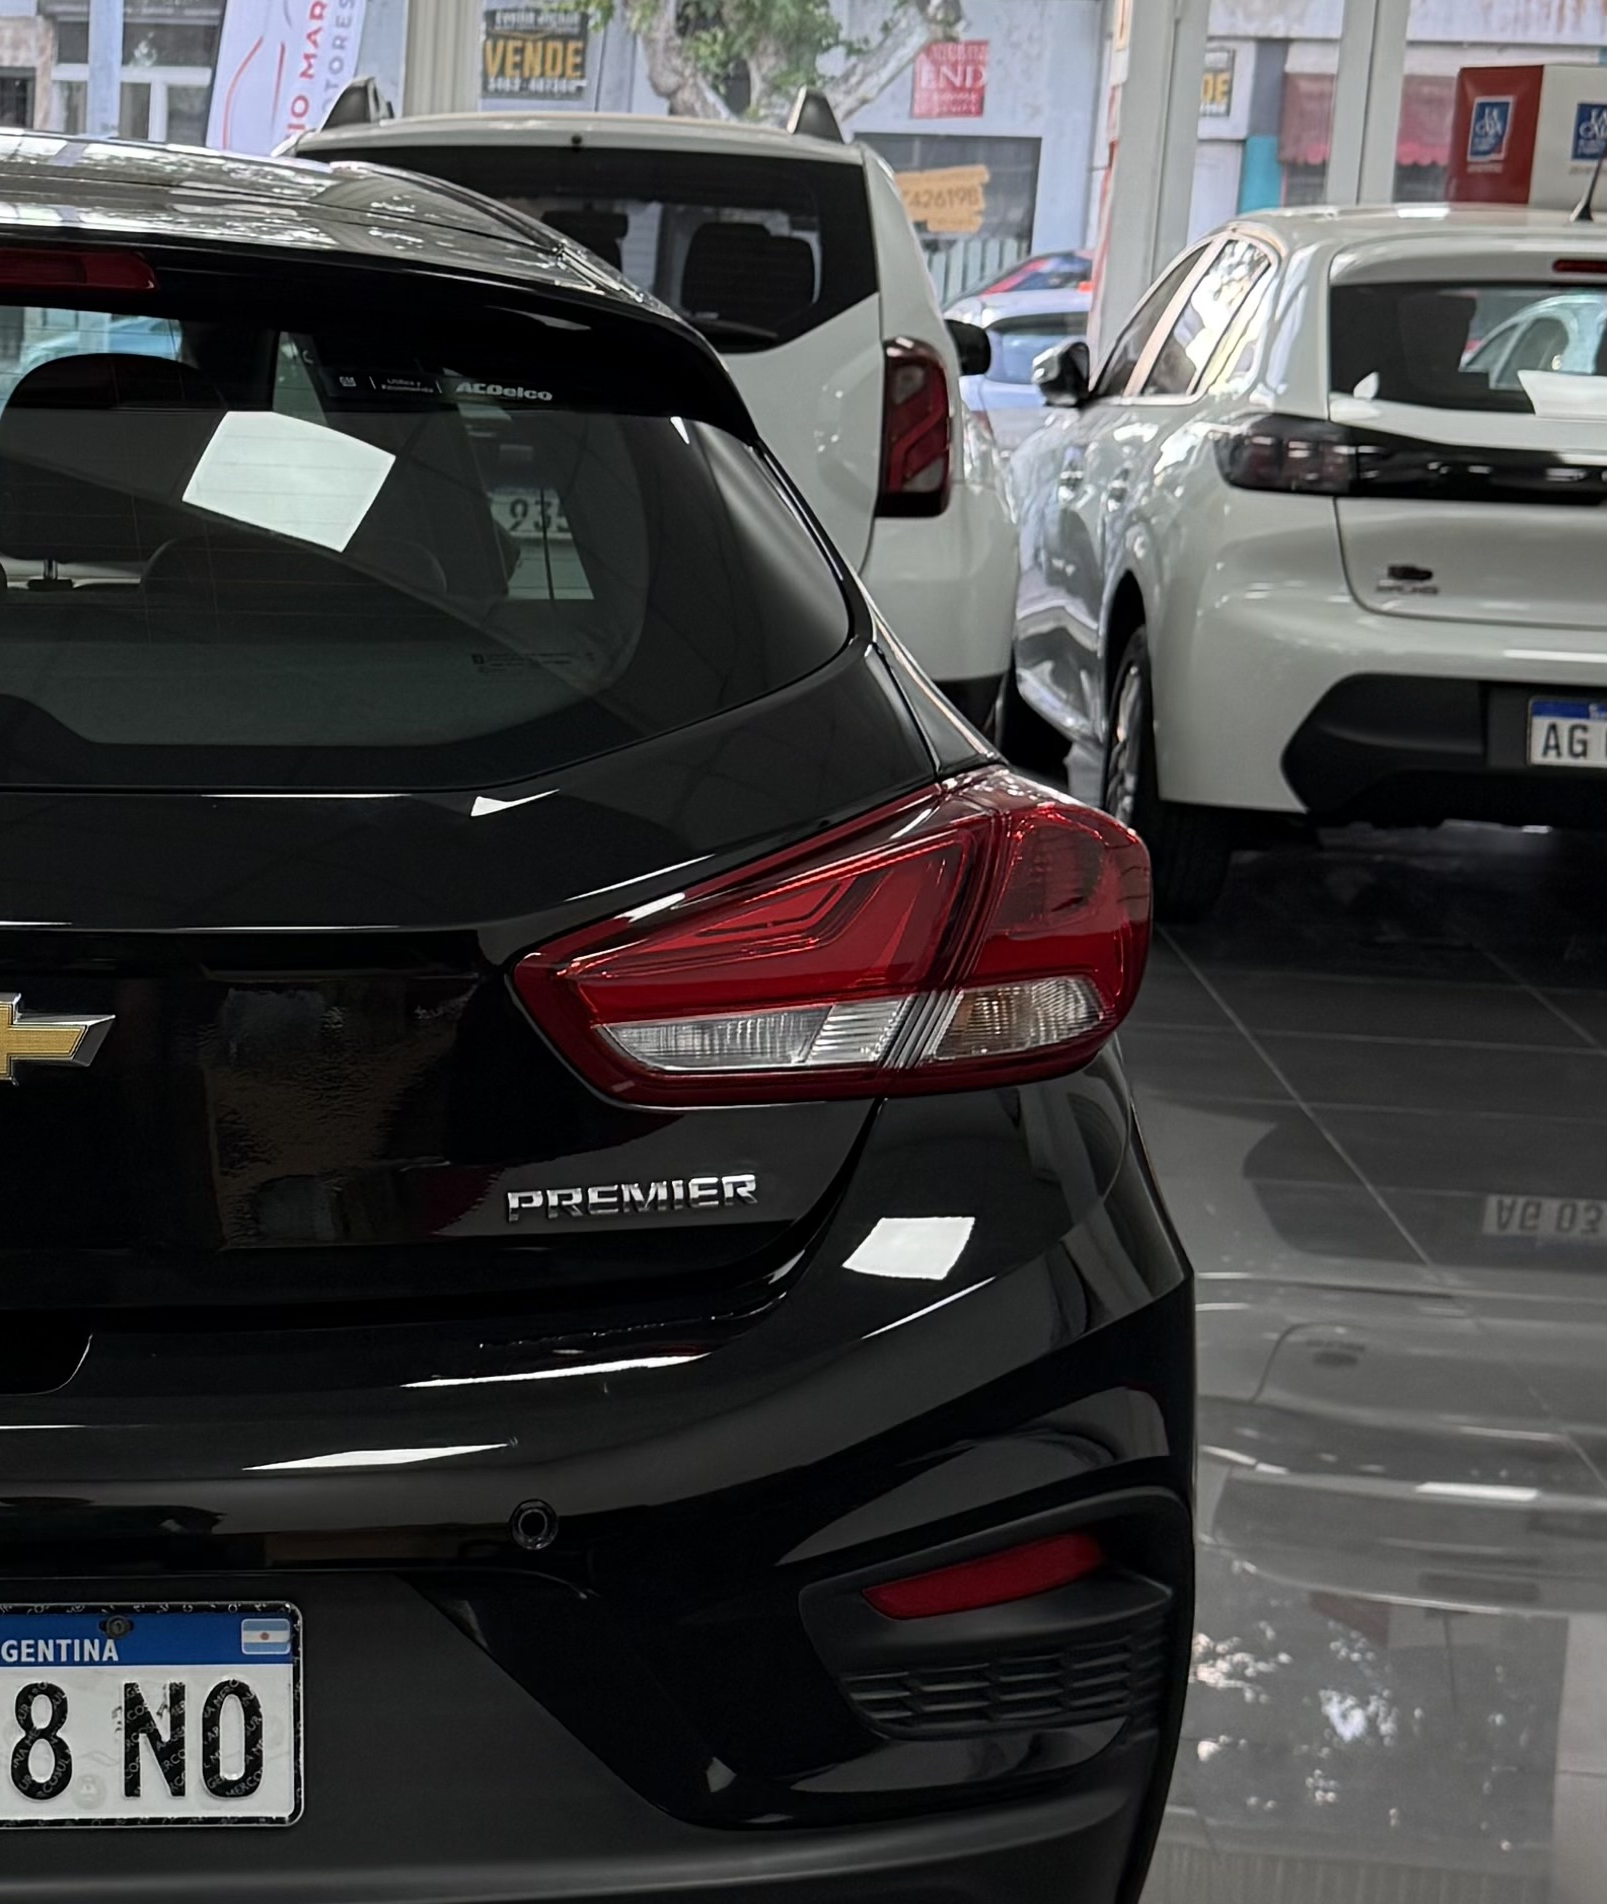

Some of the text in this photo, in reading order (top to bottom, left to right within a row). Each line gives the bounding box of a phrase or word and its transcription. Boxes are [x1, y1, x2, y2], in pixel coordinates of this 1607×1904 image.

[485, 39, 583, 80] VENDE
[456, 382, 553, 401] ACDelco
[1541, 722, 1589, 759] AG
[507, 1173, 758, 1223] PREMIER
[122, 1678, 265, 1800] NO
